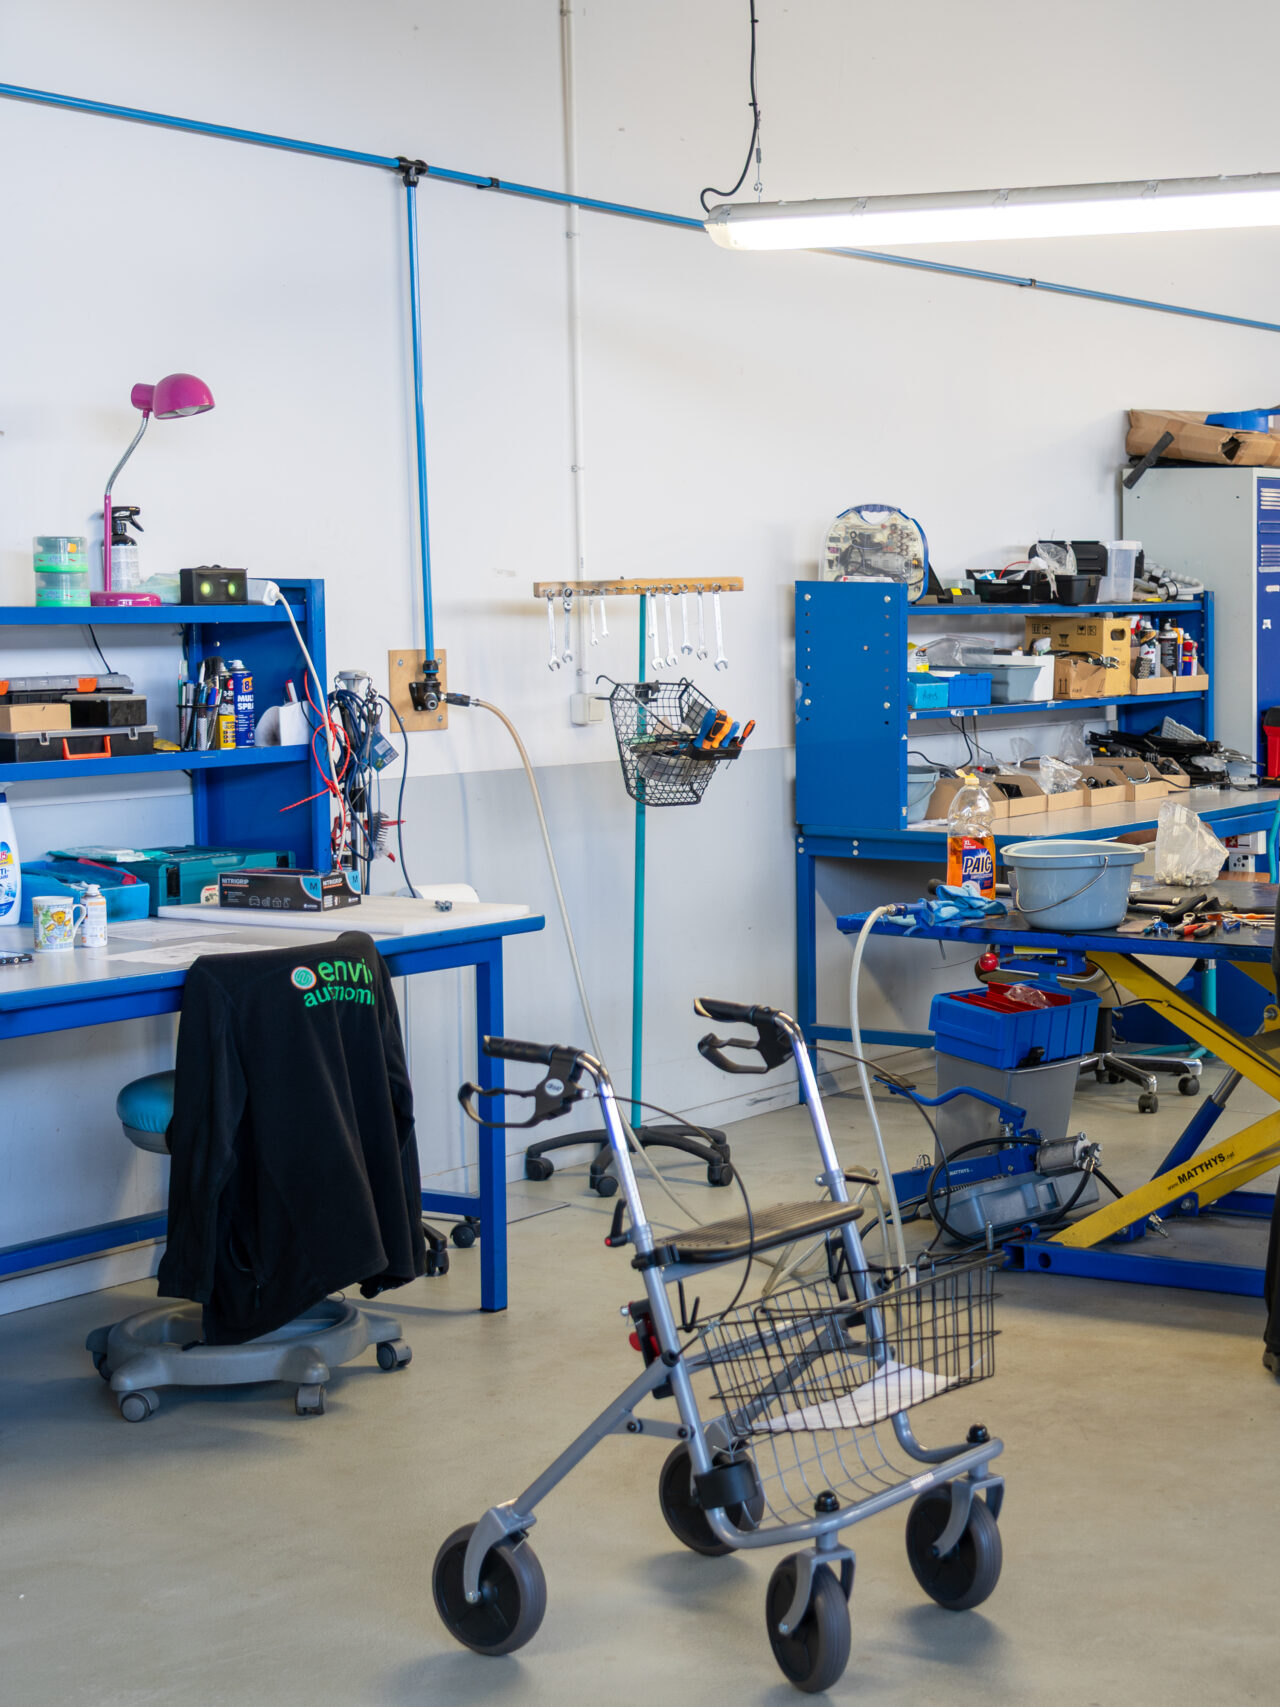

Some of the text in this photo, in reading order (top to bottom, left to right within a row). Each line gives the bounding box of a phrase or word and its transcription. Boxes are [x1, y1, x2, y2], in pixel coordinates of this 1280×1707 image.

[963, 855, 992, 875] PAIC
[310, 882, 318, 891] M
[318, 958, 373, 985] envi
